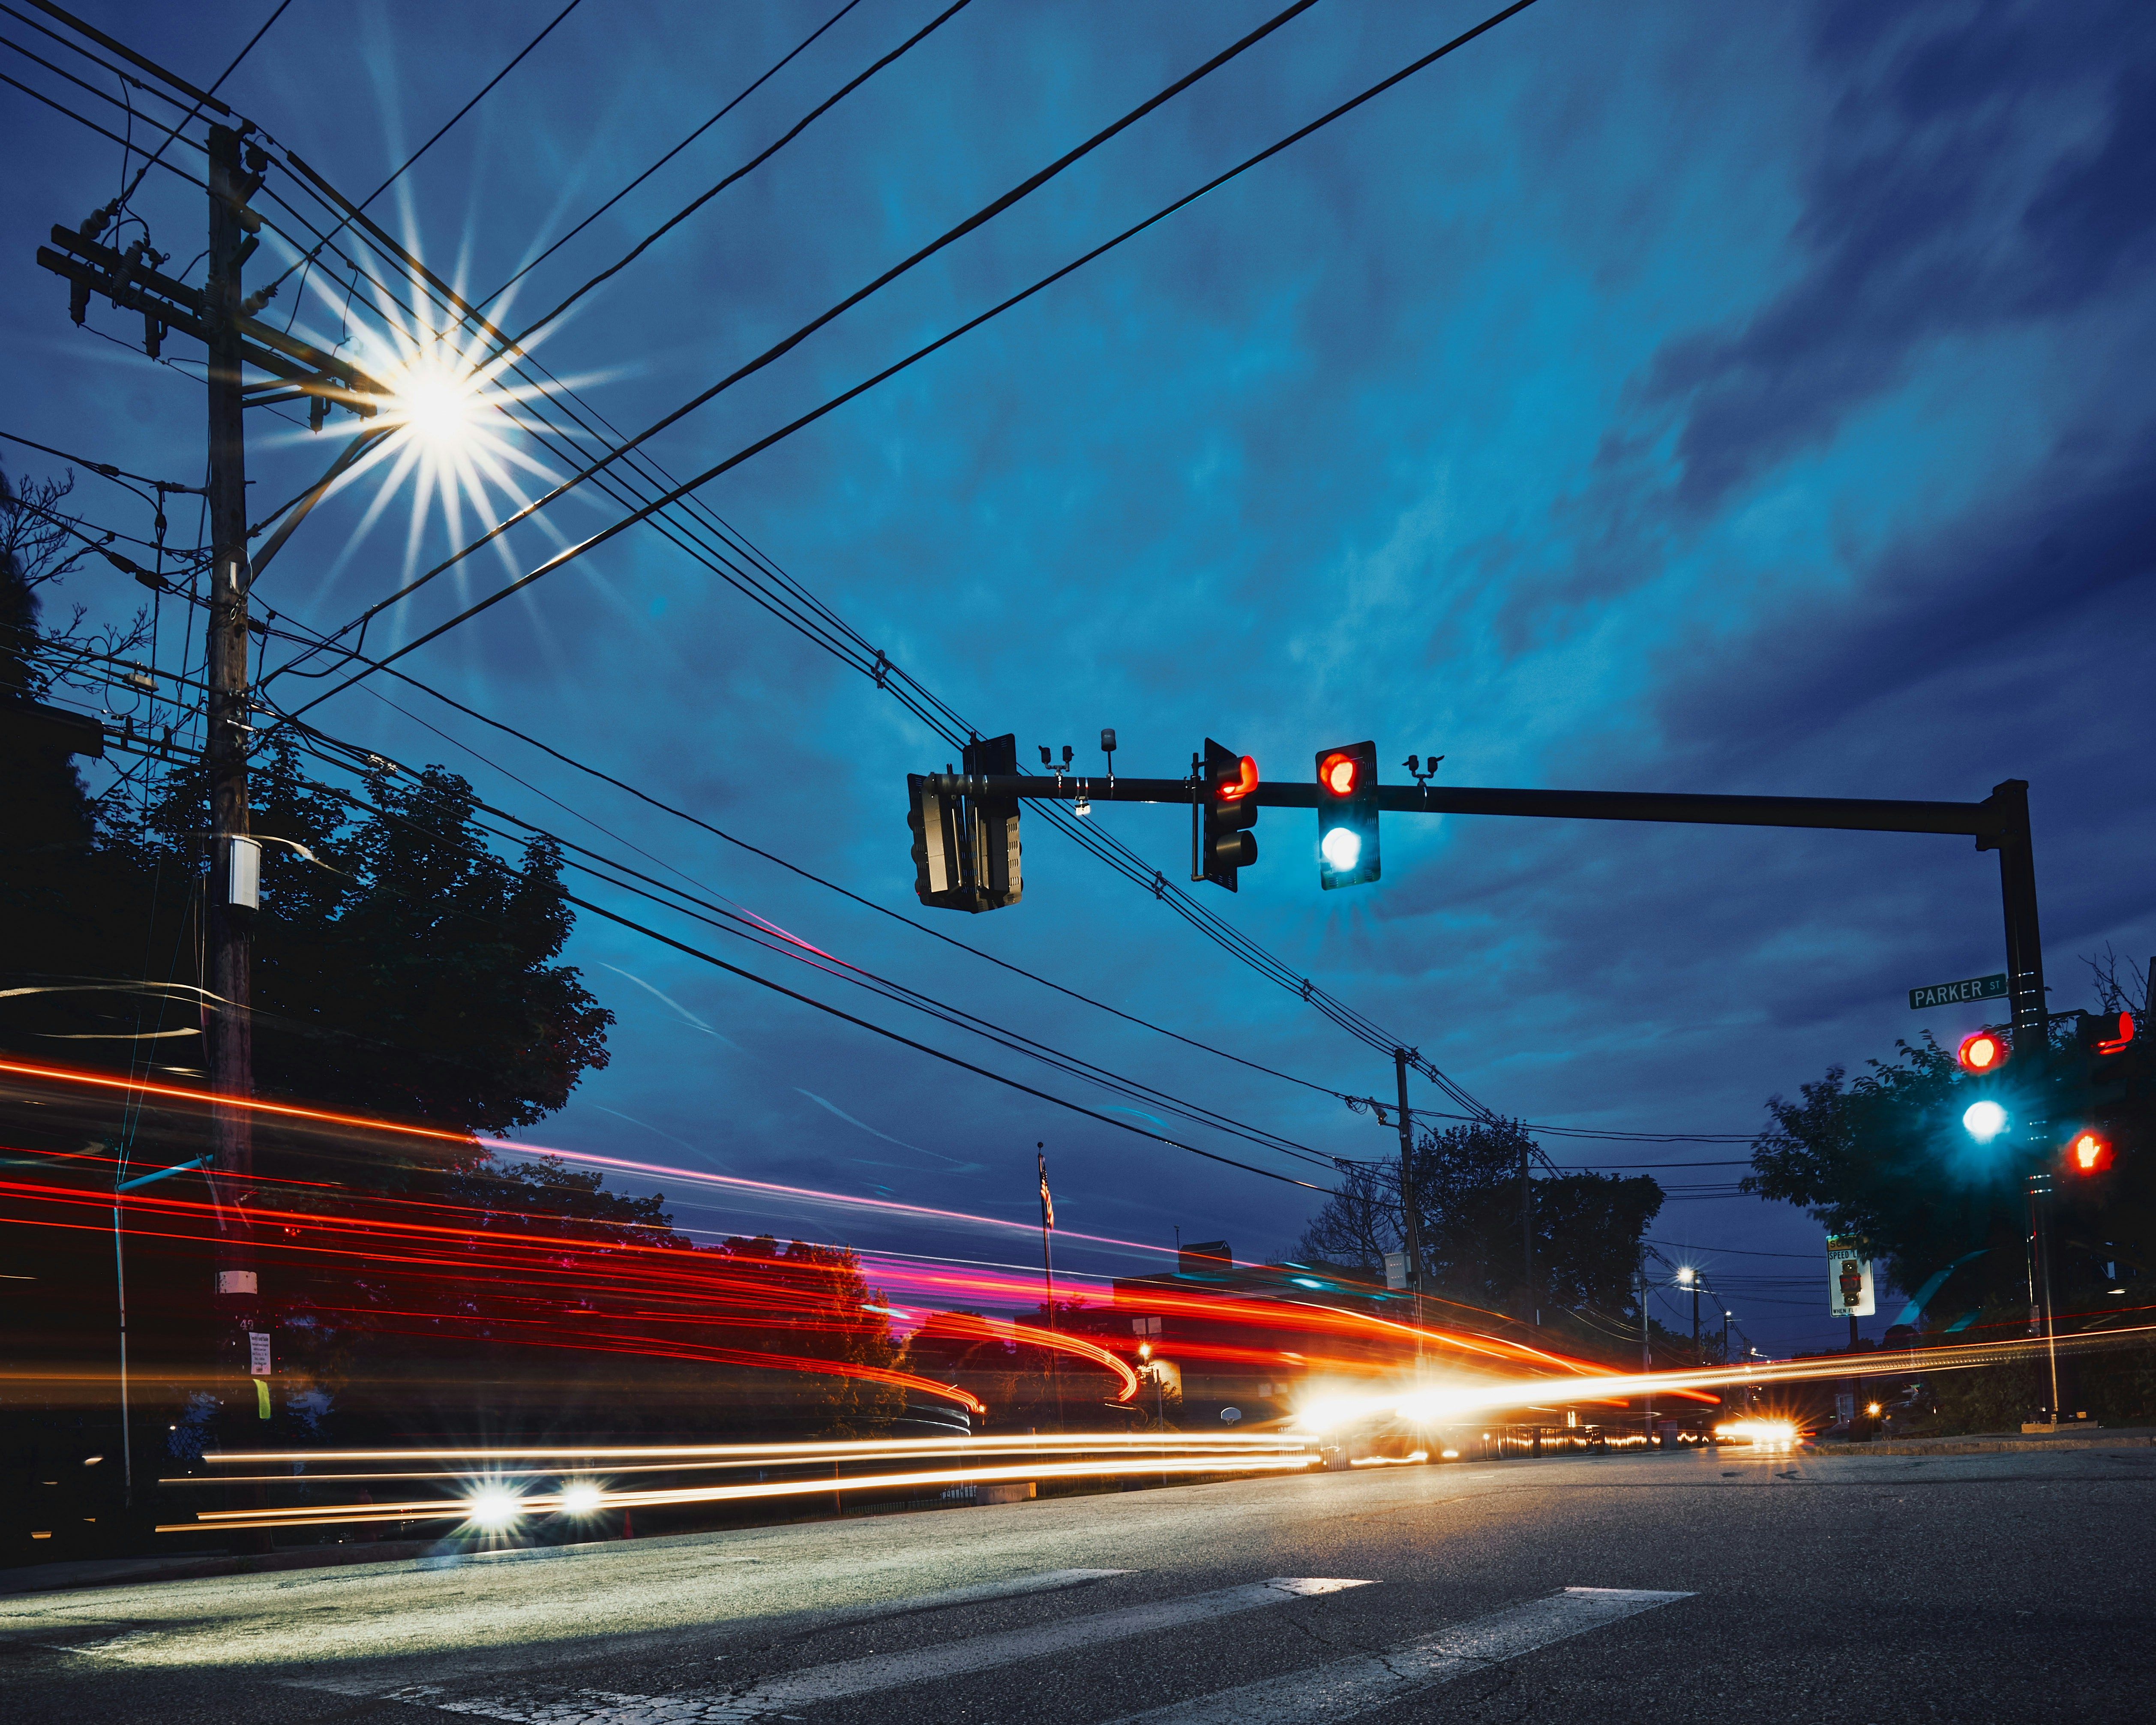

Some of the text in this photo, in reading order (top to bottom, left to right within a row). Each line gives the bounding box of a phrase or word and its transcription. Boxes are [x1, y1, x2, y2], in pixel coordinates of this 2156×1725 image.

[1915, 981, 2000, 1007] PARKER ST
[1829, 1251, 1849, 1260] SPEED
